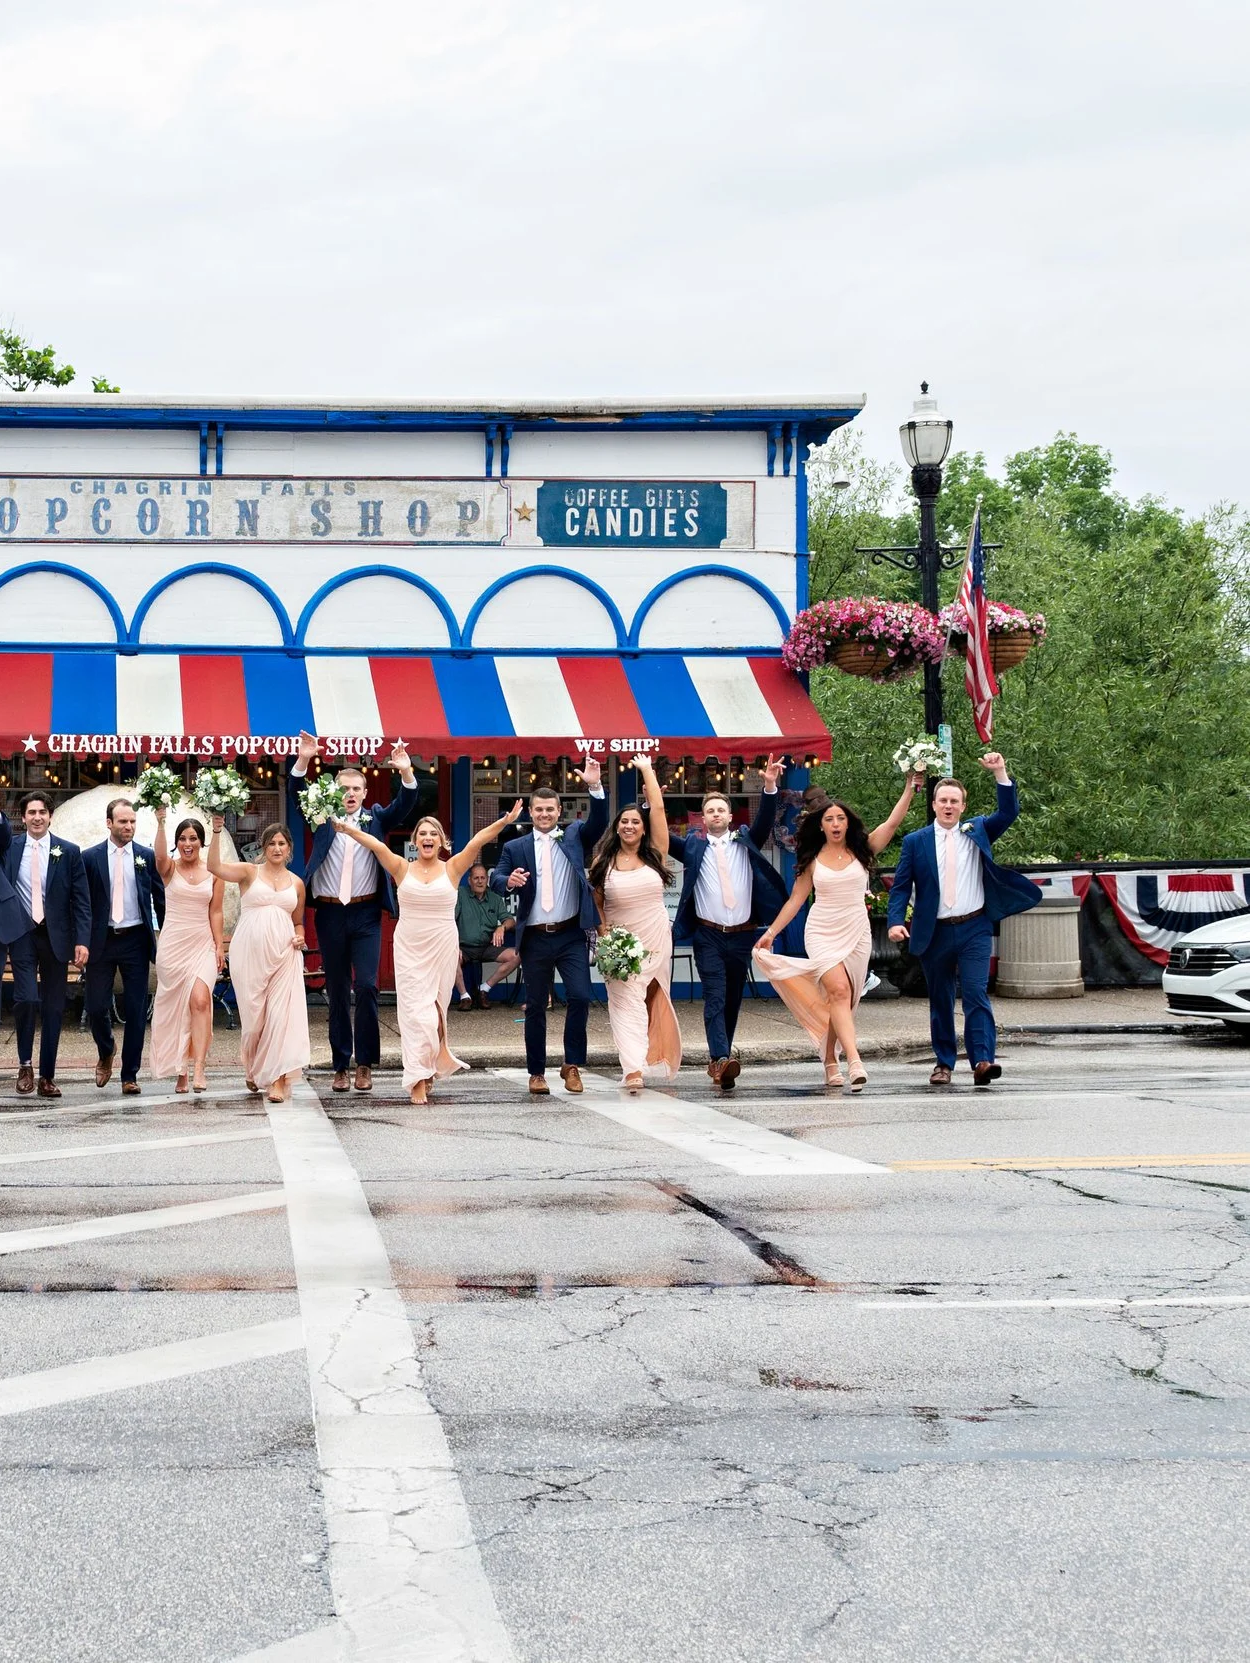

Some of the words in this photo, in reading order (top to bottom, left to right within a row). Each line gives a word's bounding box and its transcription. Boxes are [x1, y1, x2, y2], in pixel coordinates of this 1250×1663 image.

[70, 481, 212, 495] CHAGRIN
[260, 481, 356, 496] FALLS
[564, 488, 630, 507] COFFEE
[645, 488, 700, 507] GIFTS
[310, 499, 481, 537] SHOP
[565, 507, 699, 537] CANDIES
[47, 734, 142, 753] CHAGRIN
[149, 735, 215, 755] FALLS
[220, 736, 319, 756] POPCOR
[325, 737, 383, 756] SHOP
[574, 739, 605, 752] WE
[610, 738, 660, 752] SHIP!
